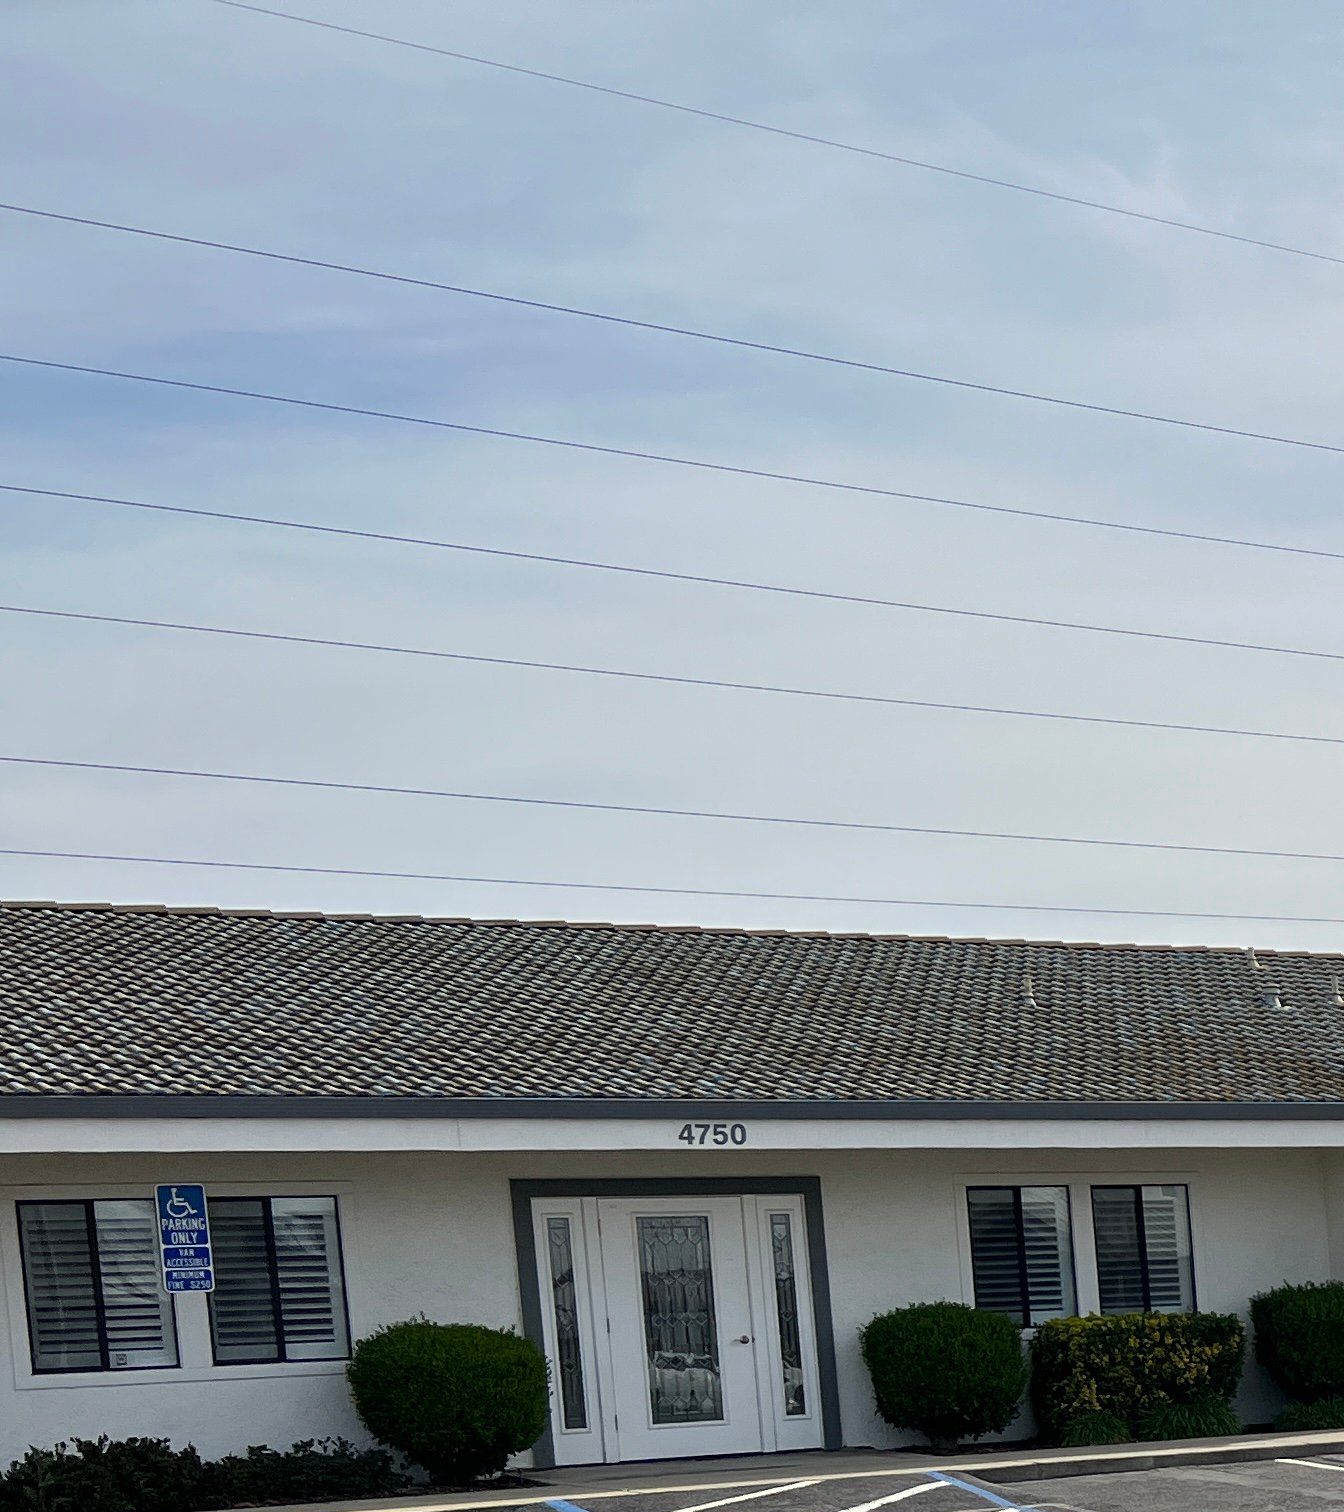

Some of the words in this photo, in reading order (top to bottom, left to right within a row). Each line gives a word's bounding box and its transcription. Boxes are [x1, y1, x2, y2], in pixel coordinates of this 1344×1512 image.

[678, 1123, 747, 1145] 4750
[161, 1218, 205, 1230] PARKING
[171, 1231, 198, 1244] ONLY
[166, 1258, 208, 1267] ACCESSIBLE
[172, 1271, 205, 1279] MINIMUM
[167, 1281, 184, 1289] FINE
[189, 1280, 211, 1289] $250
